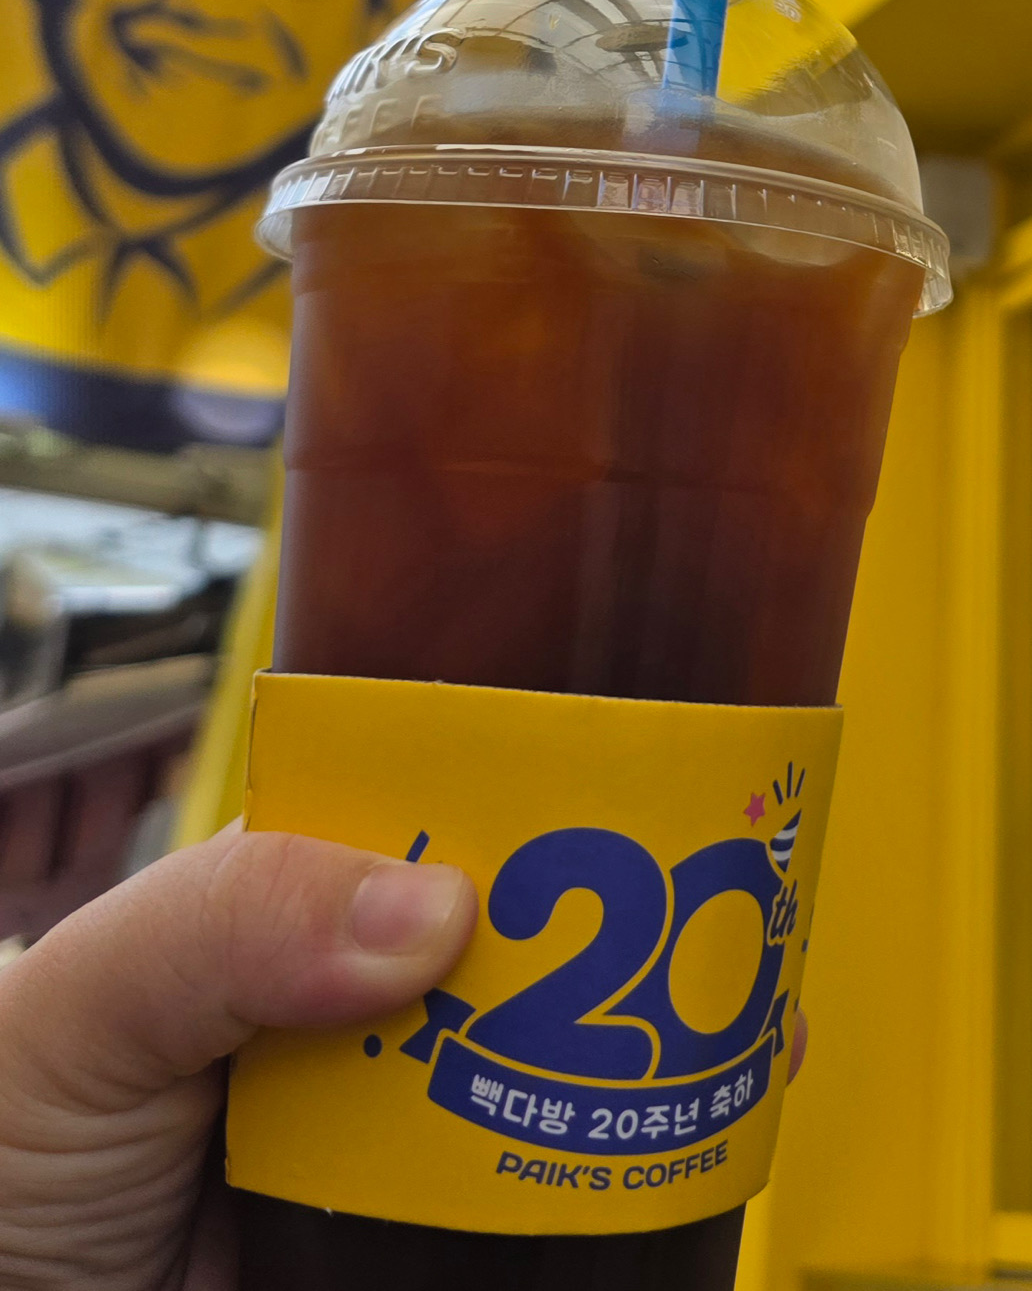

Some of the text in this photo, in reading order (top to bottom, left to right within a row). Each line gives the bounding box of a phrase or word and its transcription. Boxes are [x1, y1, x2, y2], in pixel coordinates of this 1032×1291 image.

[470, 1069, 754, 1140] 빽다방 20주년 축하
[496, 1140, 729, 1191] PAIK'S COFFEE
